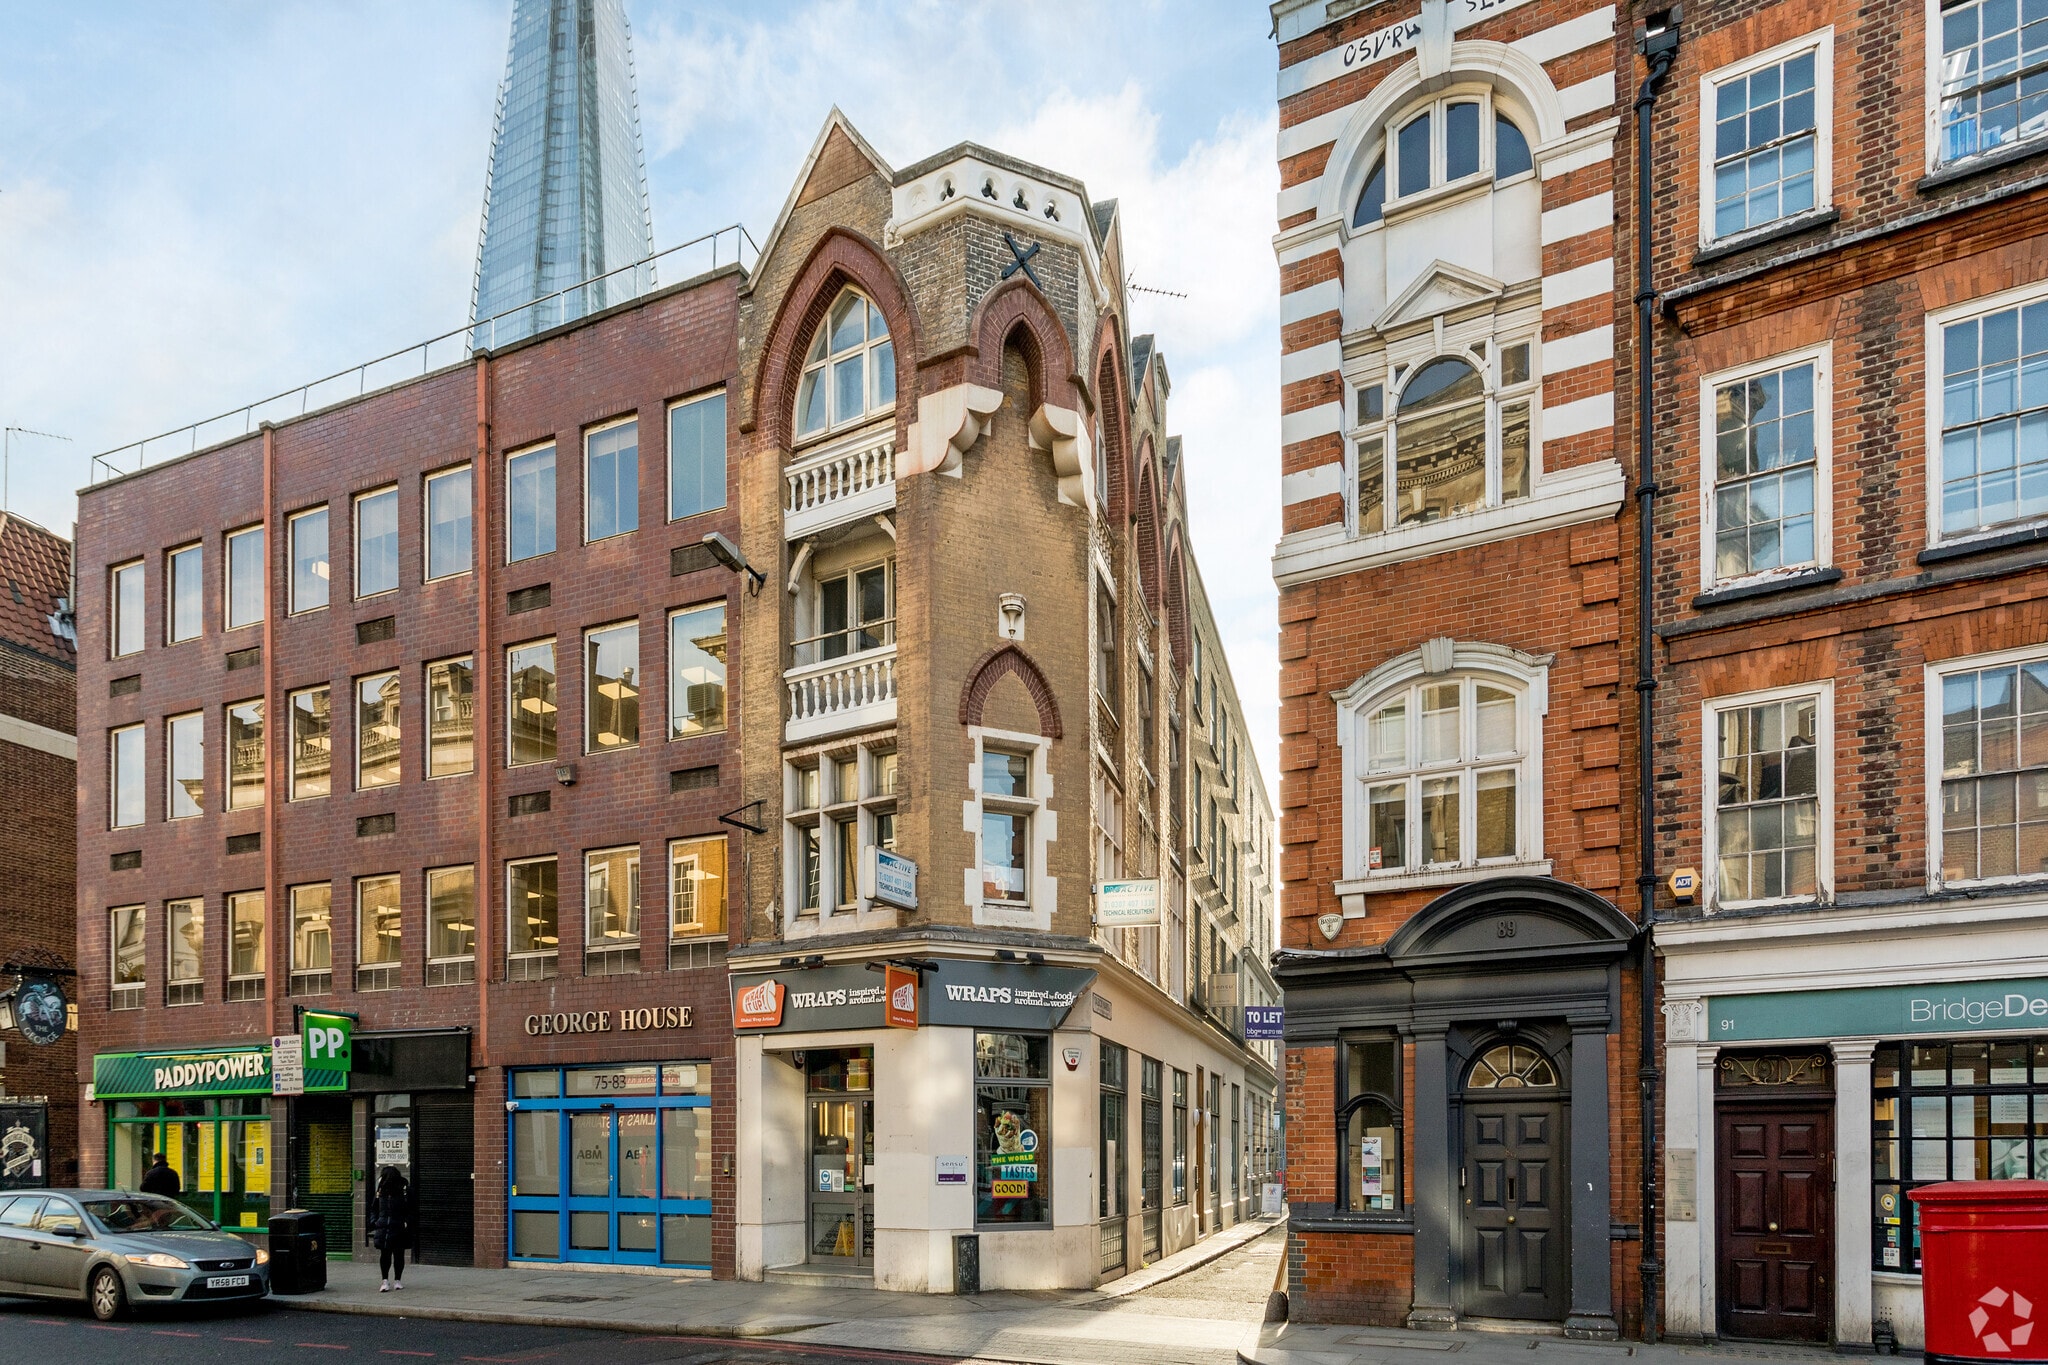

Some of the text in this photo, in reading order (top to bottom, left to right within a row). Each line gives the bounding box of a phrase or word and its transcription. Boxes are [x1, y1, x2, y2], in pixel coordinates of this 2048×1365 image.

[1676, 877, 1691, 886] ADT
[1105, 885, 1154, 893] PROACTIVE
[1127, 908, 1155, 916] RECRUITMENT
[1498, 920, 1516, 938] 89
[745, 986, 765, 1002] WRAP
[849, 986, 880, 997] inspired
[945, 984, 1012, 1004] WRAPS
[1015, 988, 1049, 999] inspired
[1054, 991, 1072, 1000] food
[746, 995, 767, 1011] IT UP!
[791, 989, 847, 1009] WRAPS
[849, 994, 876, 1004] around
[1015, 997, 1043, 1006] around
[1050, 998, 1073, 1007] world
[525, 1006, 693, 1036] GEORGE HOUSE
[1247, 1011, 1282, 1024] TO LET
[1721, 1019, 1735, 1030] 91
[23, 1027, 60, 1044] GEORGE
[594, 1074, 627, 1090] 75-83
[381, 1140, 404, 1148] TO LET
[1008, 1154, 1034, 1162] WORLD
[1005, 1165, 1035, 1179] TASTES
[995, 1183, 1026, 1193] GOOD!
[211, 1278, 230, 1287] YR58
